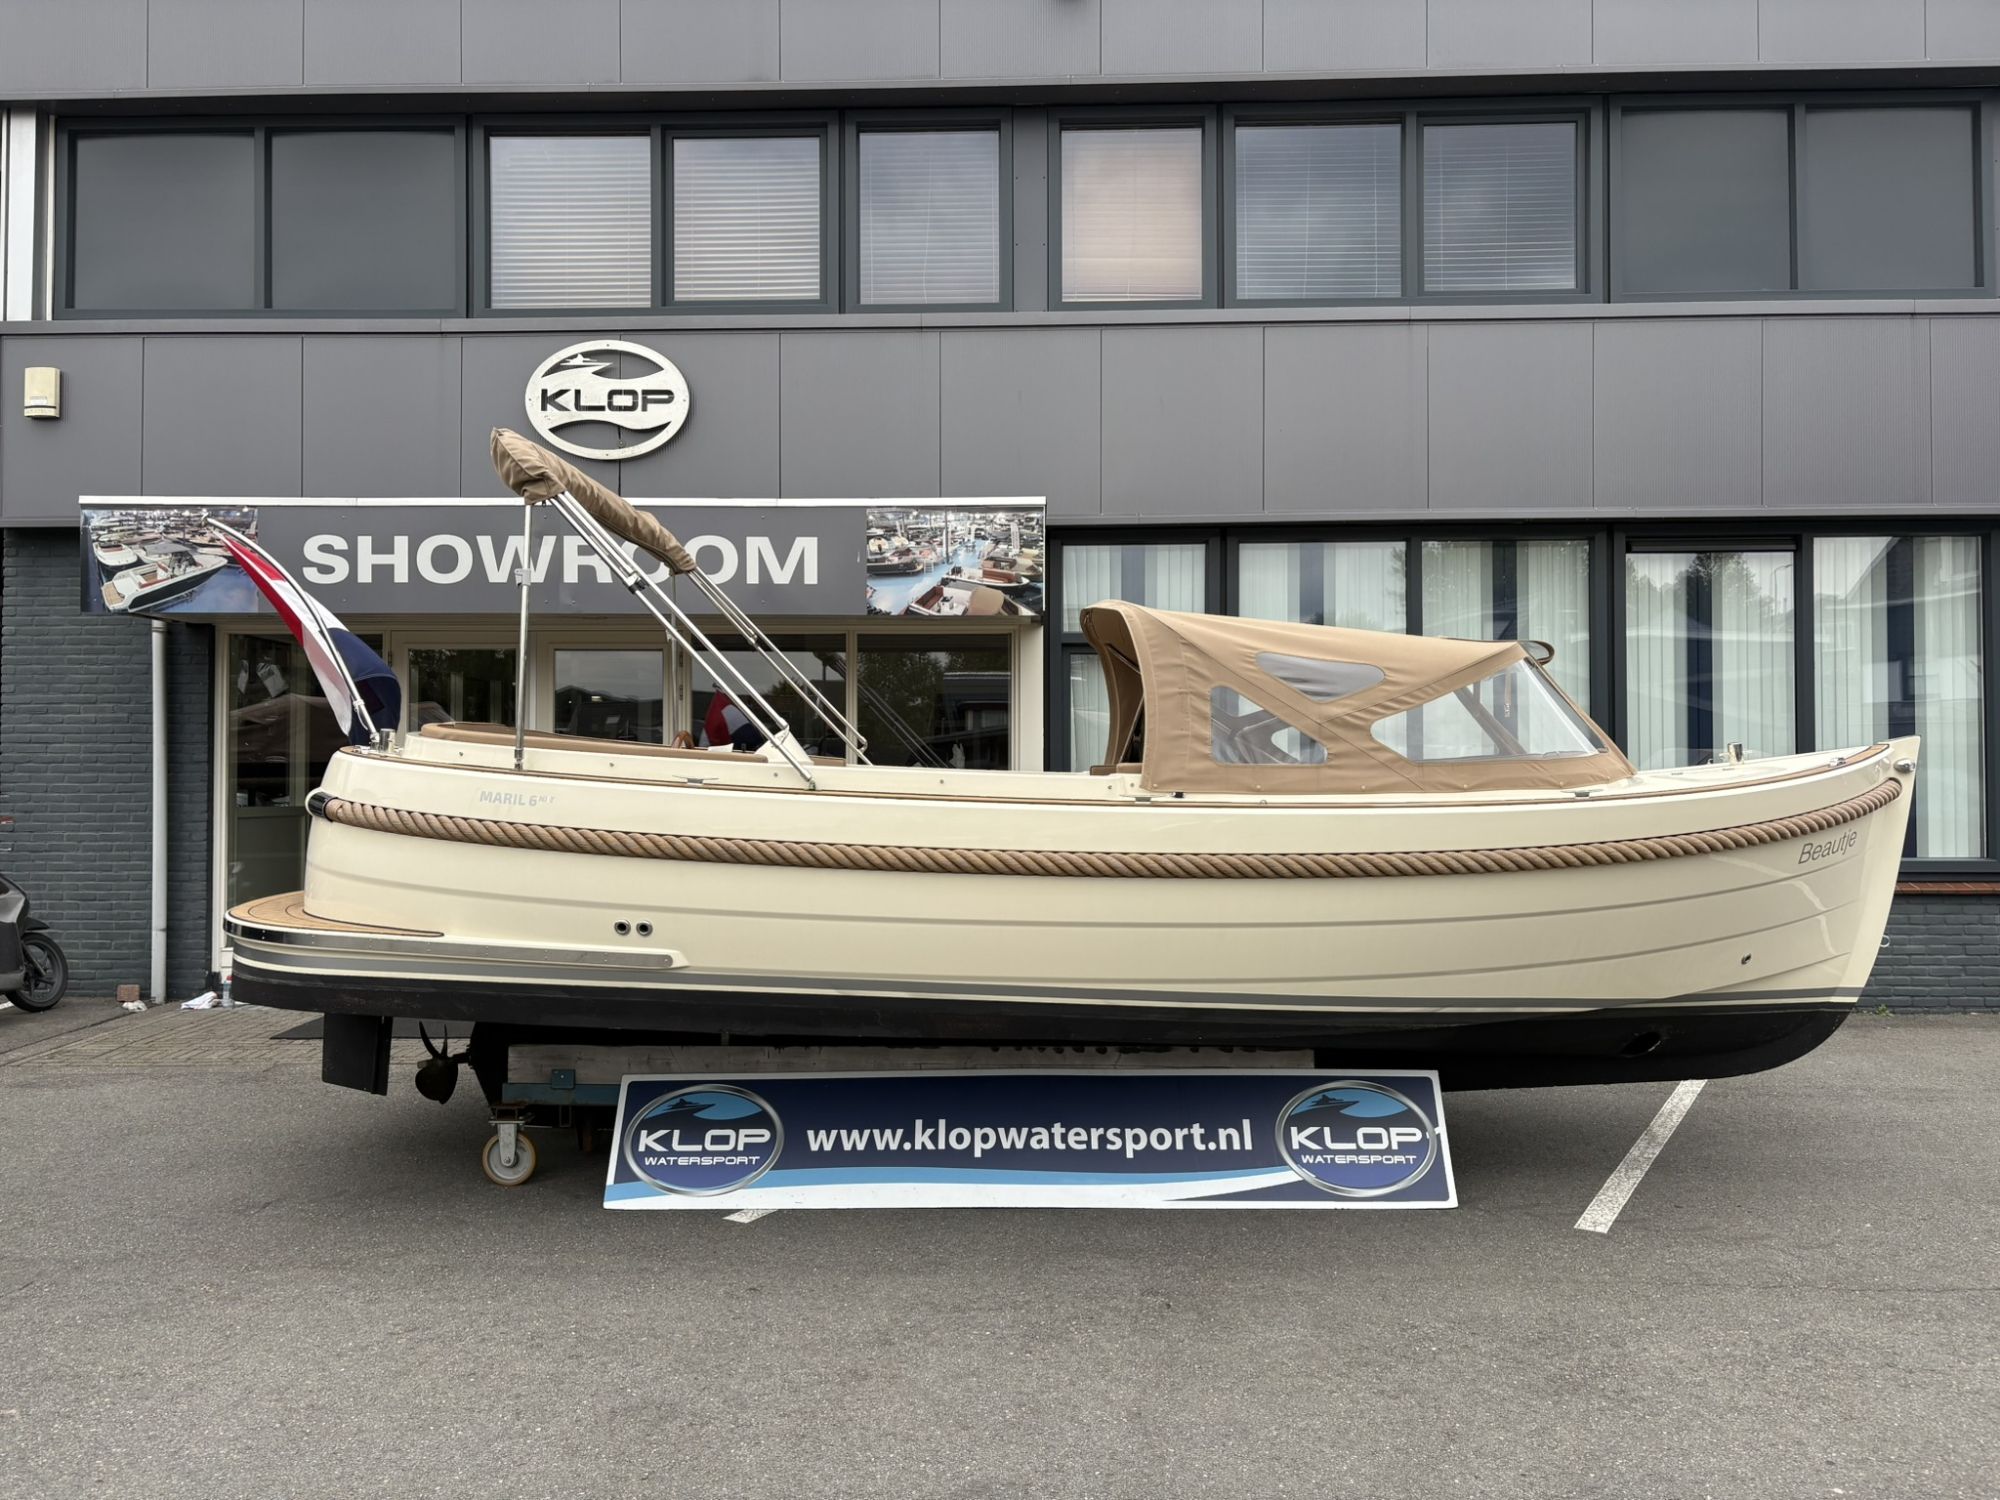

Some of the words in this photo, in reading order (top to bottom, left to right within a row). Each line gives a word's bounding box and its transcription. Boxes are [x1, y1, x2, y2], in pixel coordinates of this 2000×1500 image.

[540, 388, 675, 412] KLOP
[480, 790, 526, 807] MARIL
[1798, 828, 1858, 865] Beautje
[638, 1128, 771, 1152] KLOP
[806, 1118, 1254, 1158] www.klopwatersport.nl
[1290, 1126, 1423, 1151] KLOP
[644, 1156, 760, 1166] WATERSPORT
[1301, 1154, 1417, 1165] WATERSPORT
